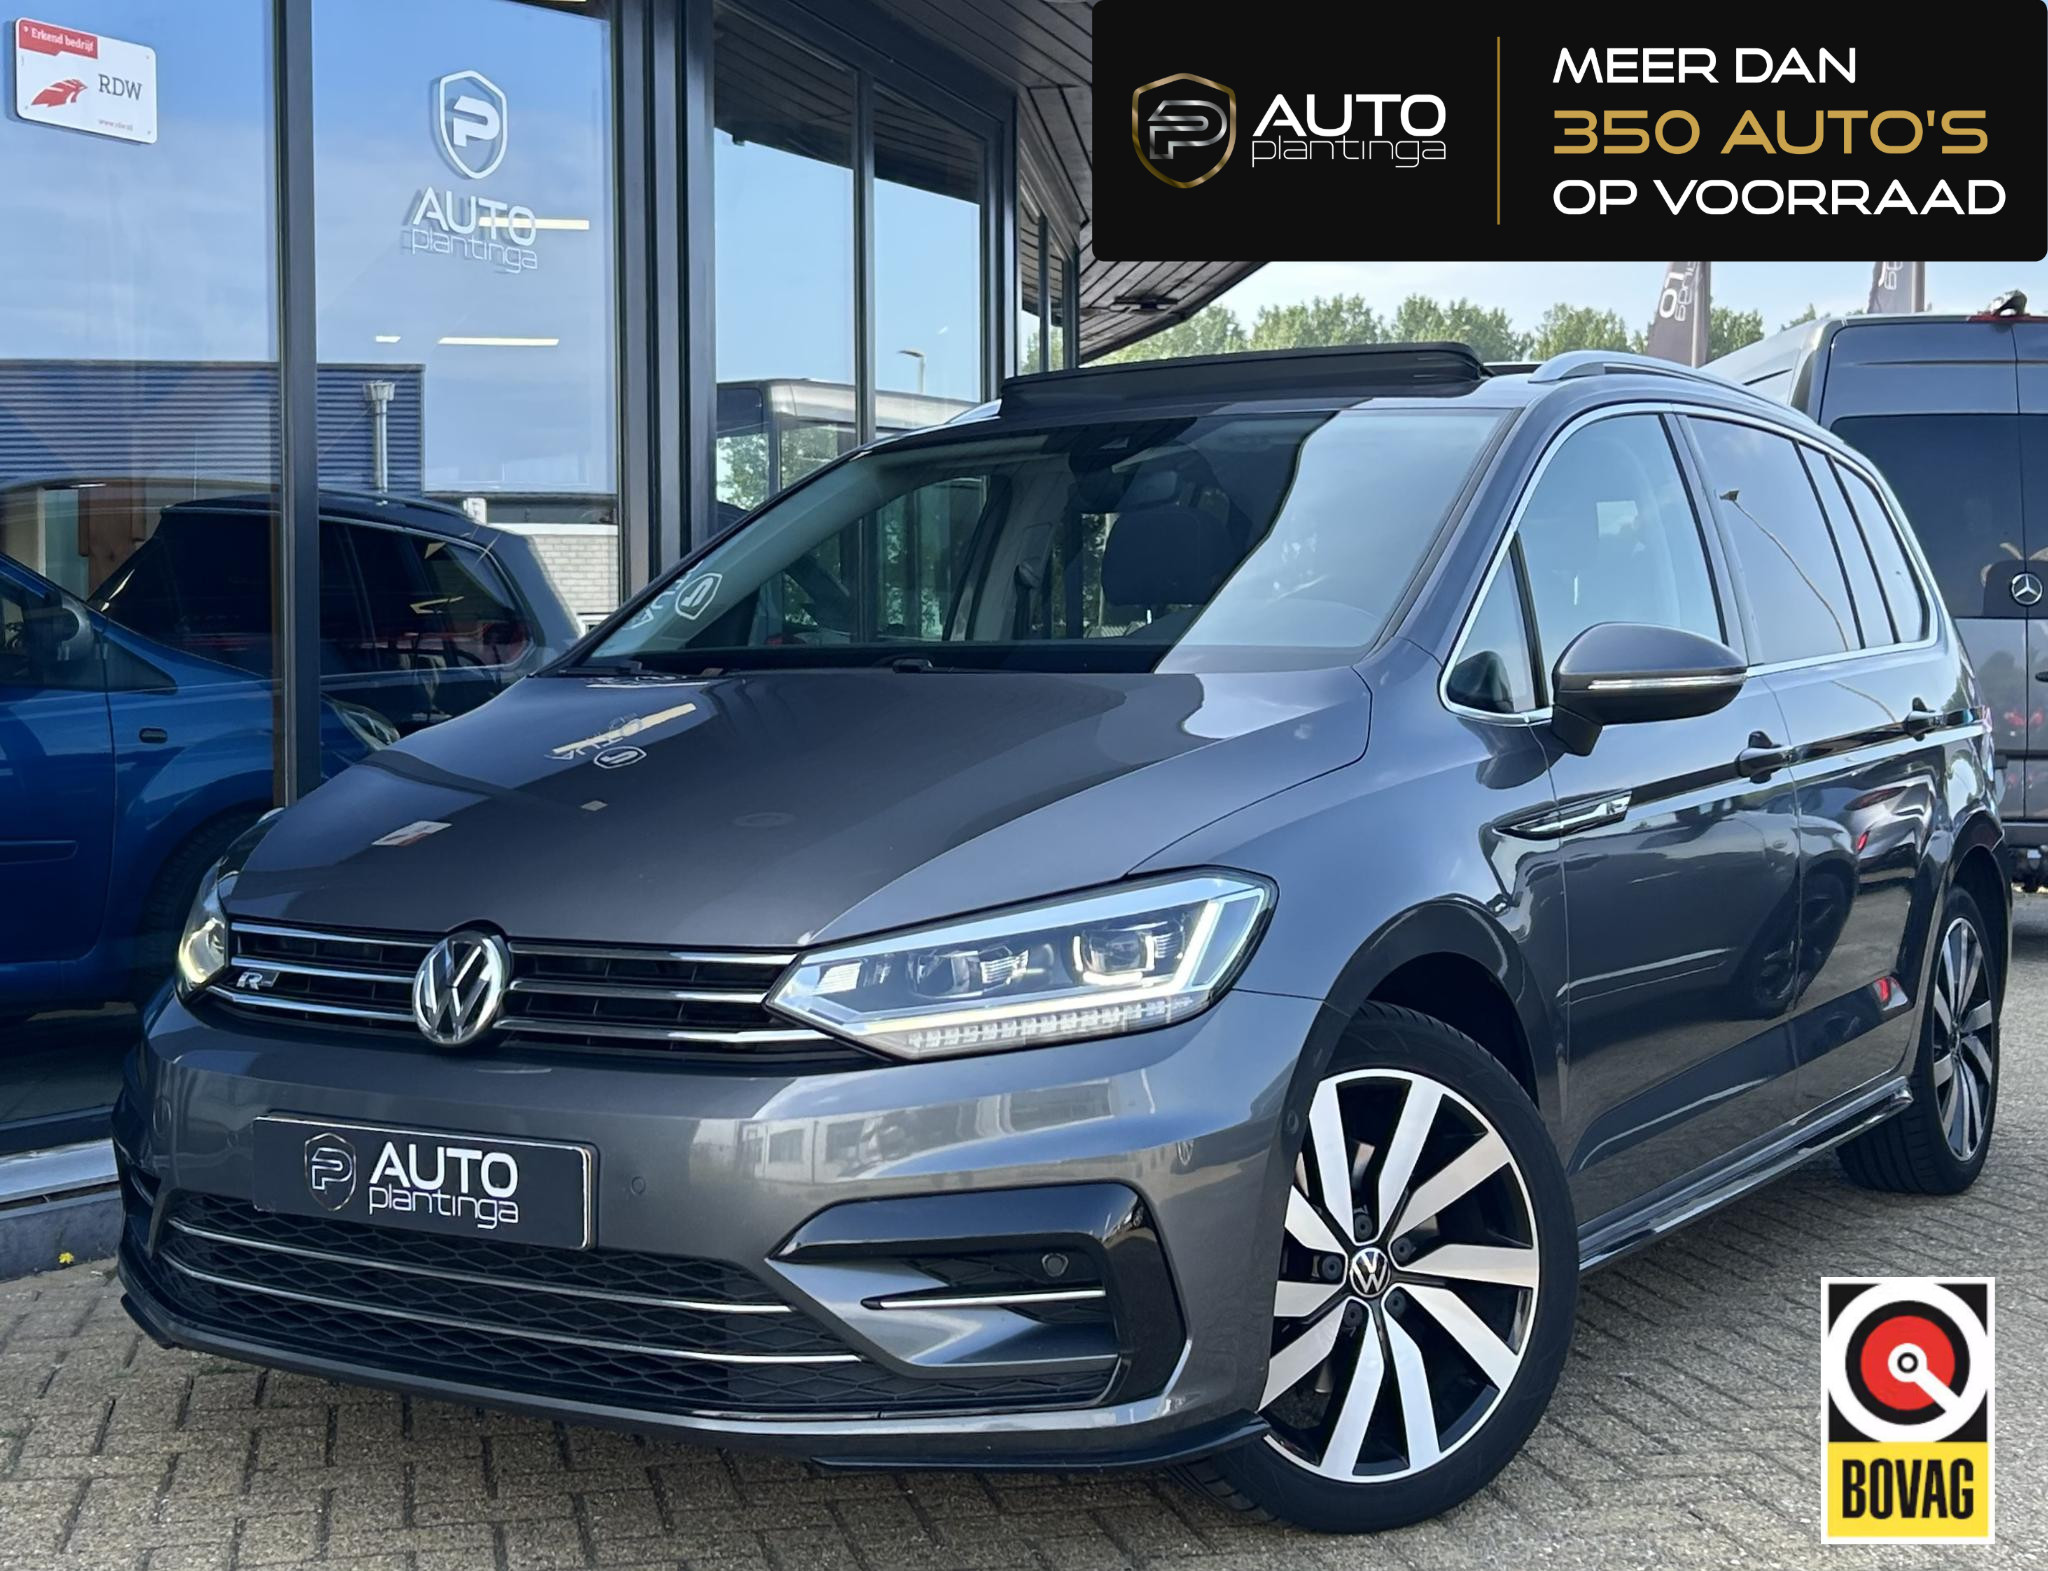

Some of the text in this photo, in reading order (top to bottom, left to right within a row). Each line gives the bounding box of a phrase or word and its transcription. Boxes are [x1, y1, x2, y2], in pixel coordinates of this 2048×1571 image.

[98, 73, 143, 101] RDW
[412, 186, 536, 246] AUTO
[410, 227, 538, 274] plantinga
[369, 1141, 519, 1198] AUTO
[368, 1183, 519, 1229] plantinga
